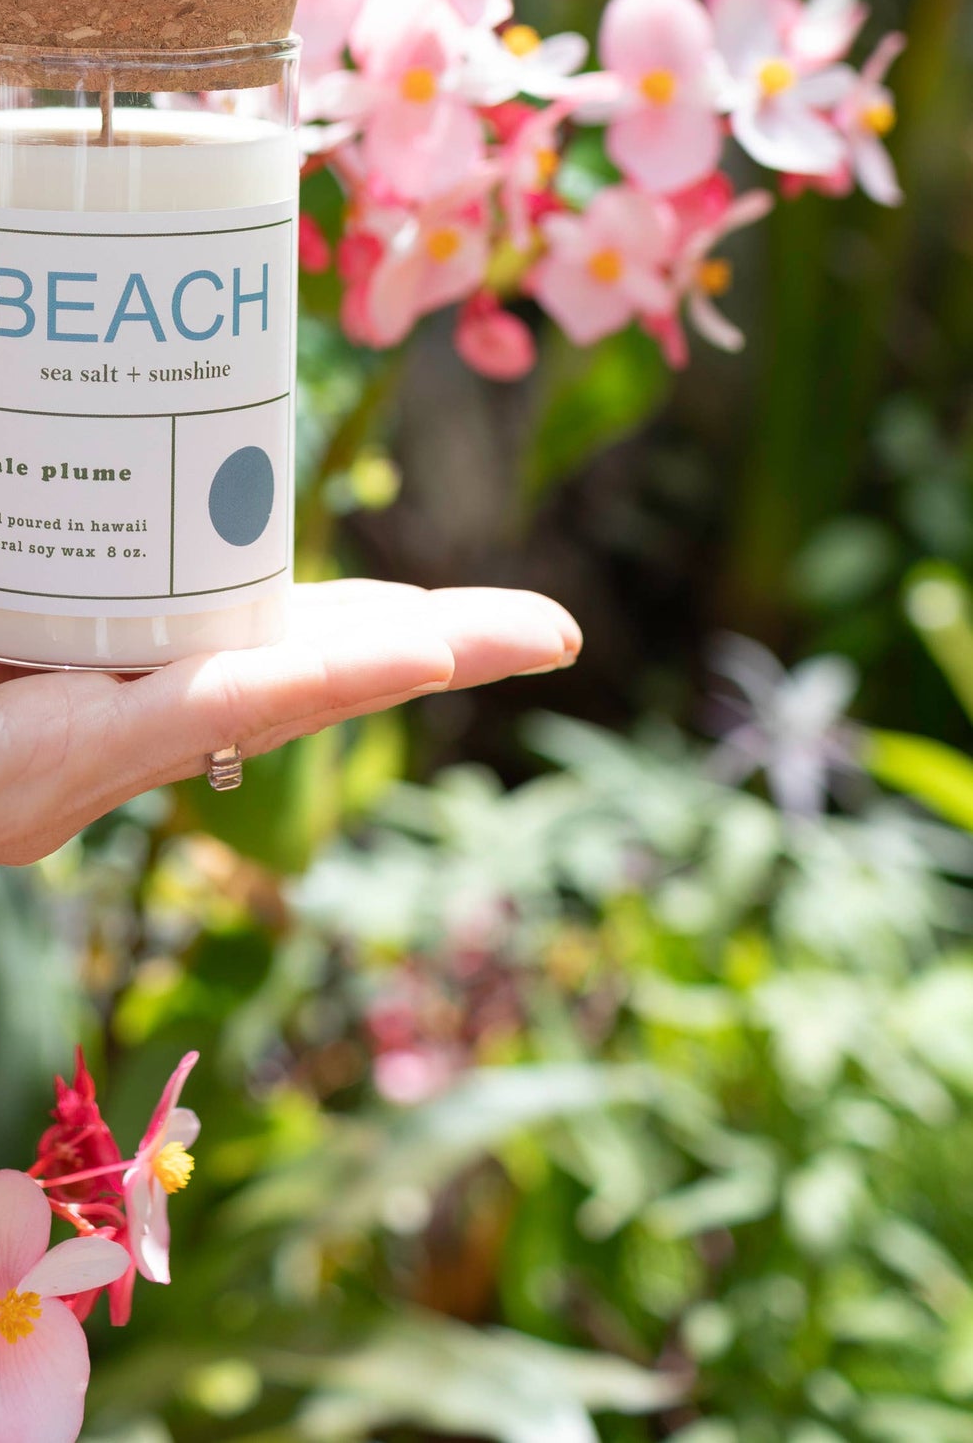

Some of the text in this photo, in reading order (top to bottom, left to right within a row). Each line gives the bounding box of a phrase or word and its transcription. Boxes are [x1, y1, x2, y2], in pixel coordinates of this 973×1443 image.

[40, 360, 231, 383] sea salt + sunshine
[41, 462, 132, 482] plume
[7, 516, 62, 531] poured
[67, 518, 85, 532] in
[90, 519, 148, 533] hawaii
[28, 544, 56, 559] soy
[60, 547, 96, 558] wax
[106, 545, 117, 558] 8
[123, 548, 147, 558] oz.
